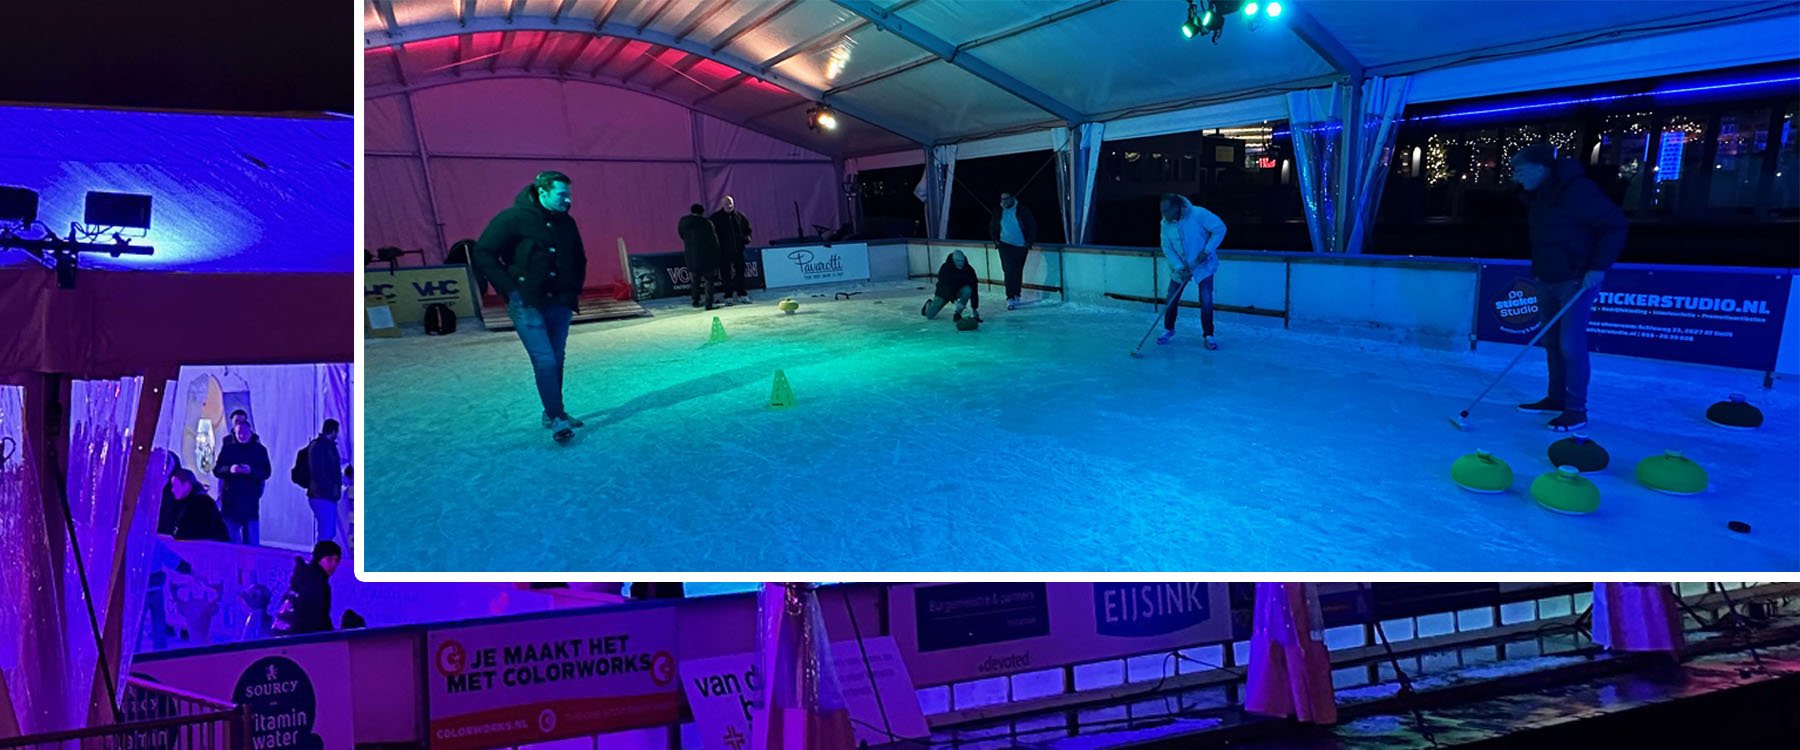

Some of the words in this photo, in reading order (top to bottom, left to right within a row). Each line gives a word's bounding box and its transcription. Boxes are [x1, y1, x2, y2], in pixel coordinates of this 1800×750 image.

[787, 249, 843, 273] Pavarotti
[364, 283, 396, 298] HC
[412, 280, 460, 296] VHC
[1500, 305, 1539, 318] Studio
[1592, 292, 1770, 315] TICKERSTUDIO.NL
[1103, 582, 1204, 623] EIJSINK
[470, 647, 497, 669] JE
[503, 638, 583, 666] MAAKT
[588, 634, 630, 656] HET
[446, 670, 497, 693] MET
[501, 652, 651, 688] COLORWORKS
[245, 680, 299, 698] SOURCY
[694, 672, 742, 698] van
[251, 707, 308, 732] itamin
[252, 730, 299, 750] water
